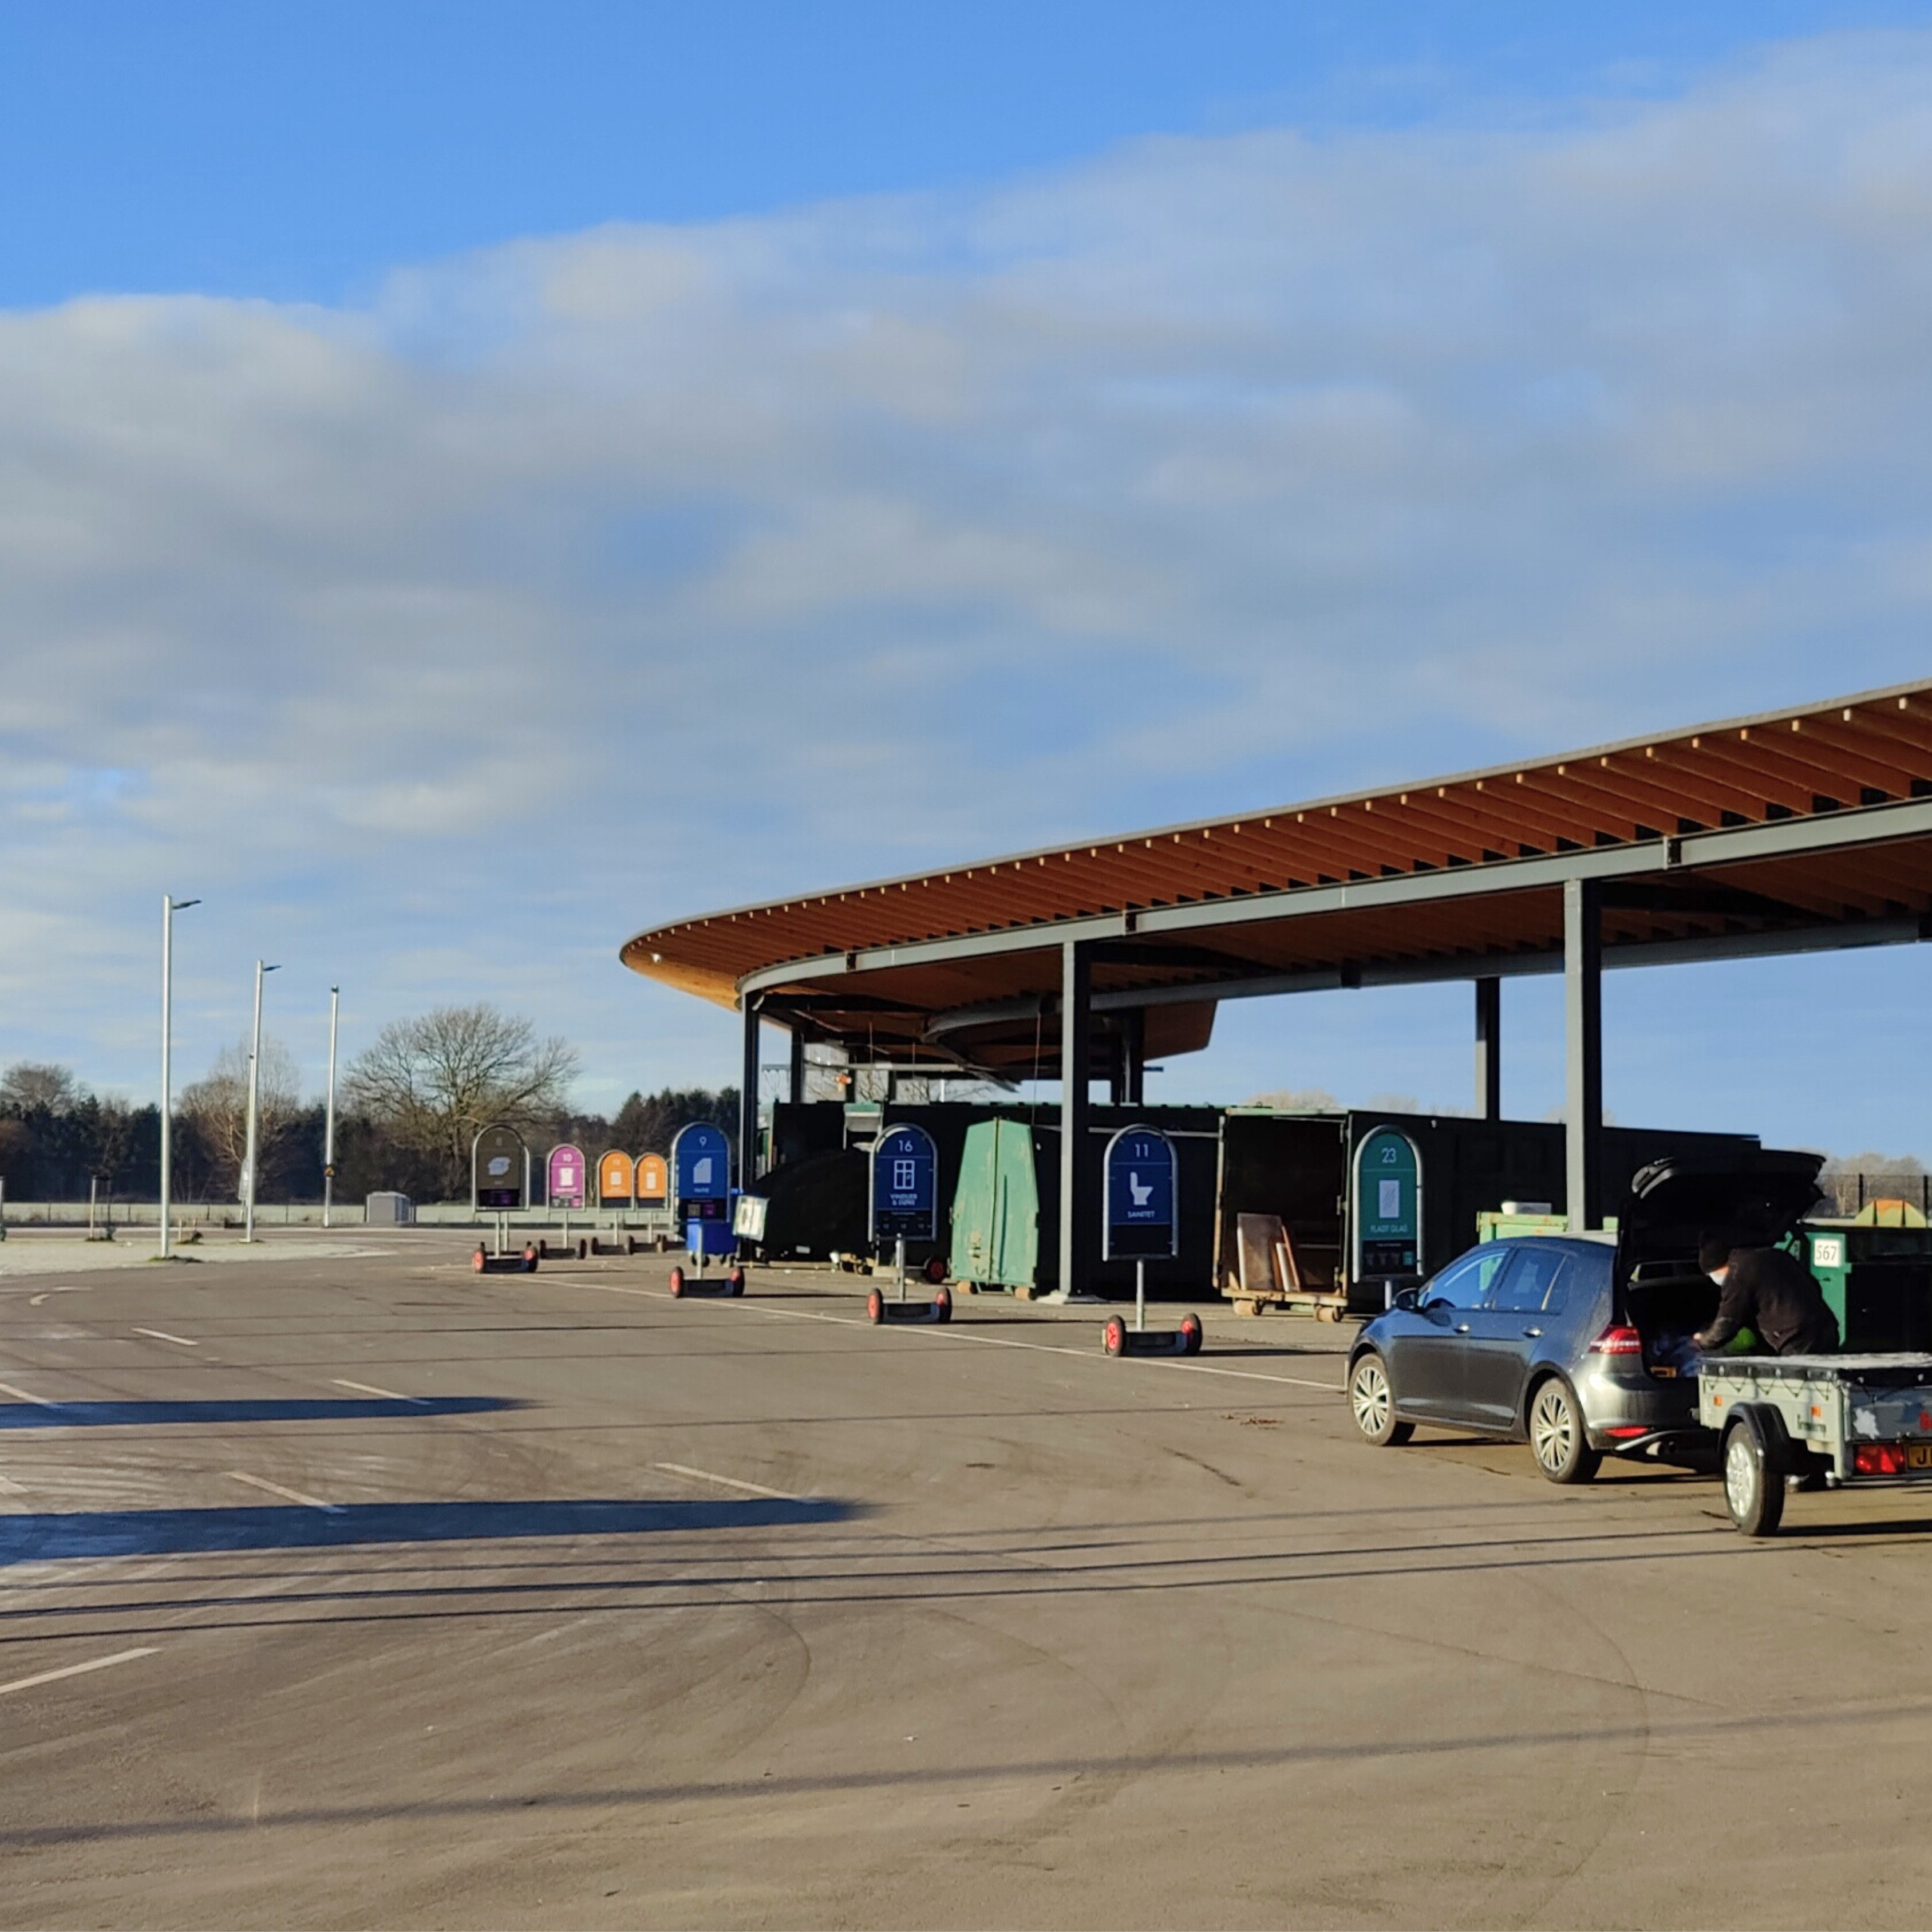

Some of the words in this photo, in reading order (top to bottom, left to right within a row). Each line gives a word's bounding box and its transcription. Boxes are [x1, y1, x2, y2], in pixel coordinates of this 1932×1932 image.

[699, 1136, 707, 1148] 9
[899, 1140, 913, 1152] 16
[1135, 1144, 1149, 1157] 11
[1382, 1148, 1396, 1163] 23
[1816, 1245, 1837, 1261] 567
